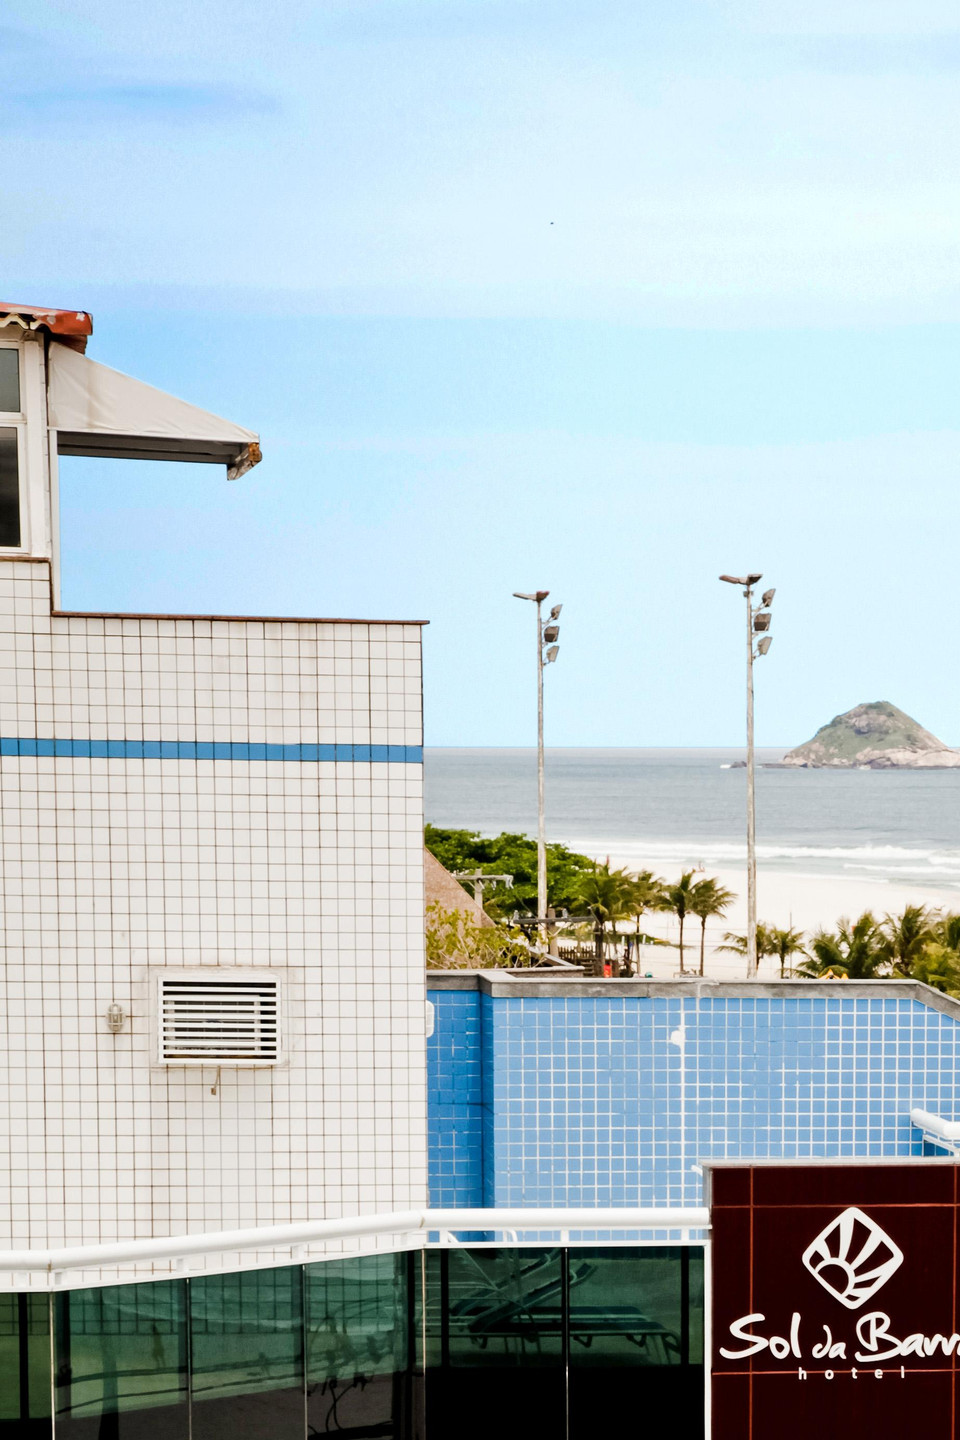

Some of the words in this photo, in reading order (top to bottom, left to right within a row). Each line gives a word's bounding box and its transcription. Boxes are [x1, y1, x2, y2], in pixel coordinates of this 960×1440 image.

[719, 1312, 802, 1360] Sol
[811, 1324, 847, 1360] da
[798, 1365, 905, 1381] hotel
